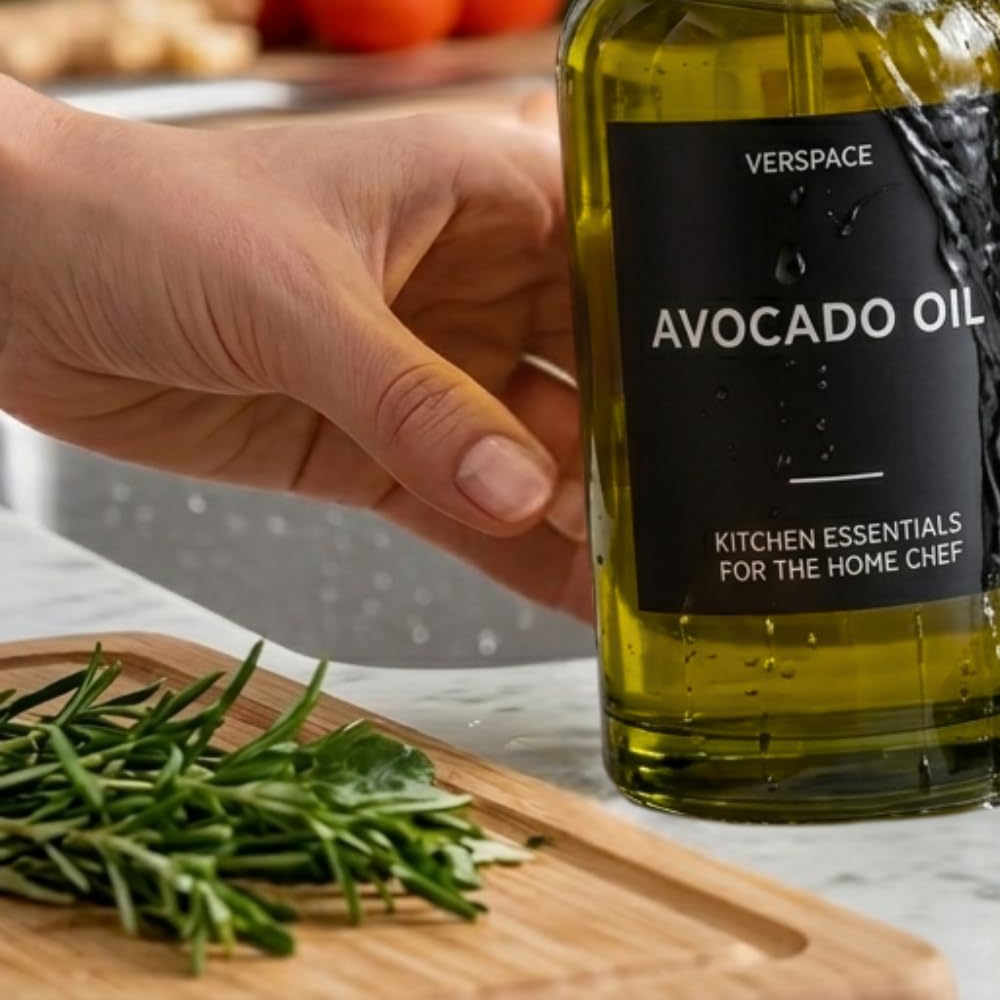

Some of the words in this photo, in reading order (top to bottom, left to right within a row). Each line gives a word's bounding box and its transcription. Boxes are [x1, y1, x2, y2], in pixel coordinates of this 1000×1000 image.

[745, 144, 873, 175] VERSPACE
[652, 297, 896, 348] AVOCADO
[913, 287, 985, 333] OIL
[715, 527, 816, 553] KITCHEN
[823, 512, 963, 549] ESSENTIALS
[719, 560, 766, 582] FOR
[772, 557, 820, 581] THE
[827, 550, 899, 577] HOME
[904, 540, 964, 570] CHEF
